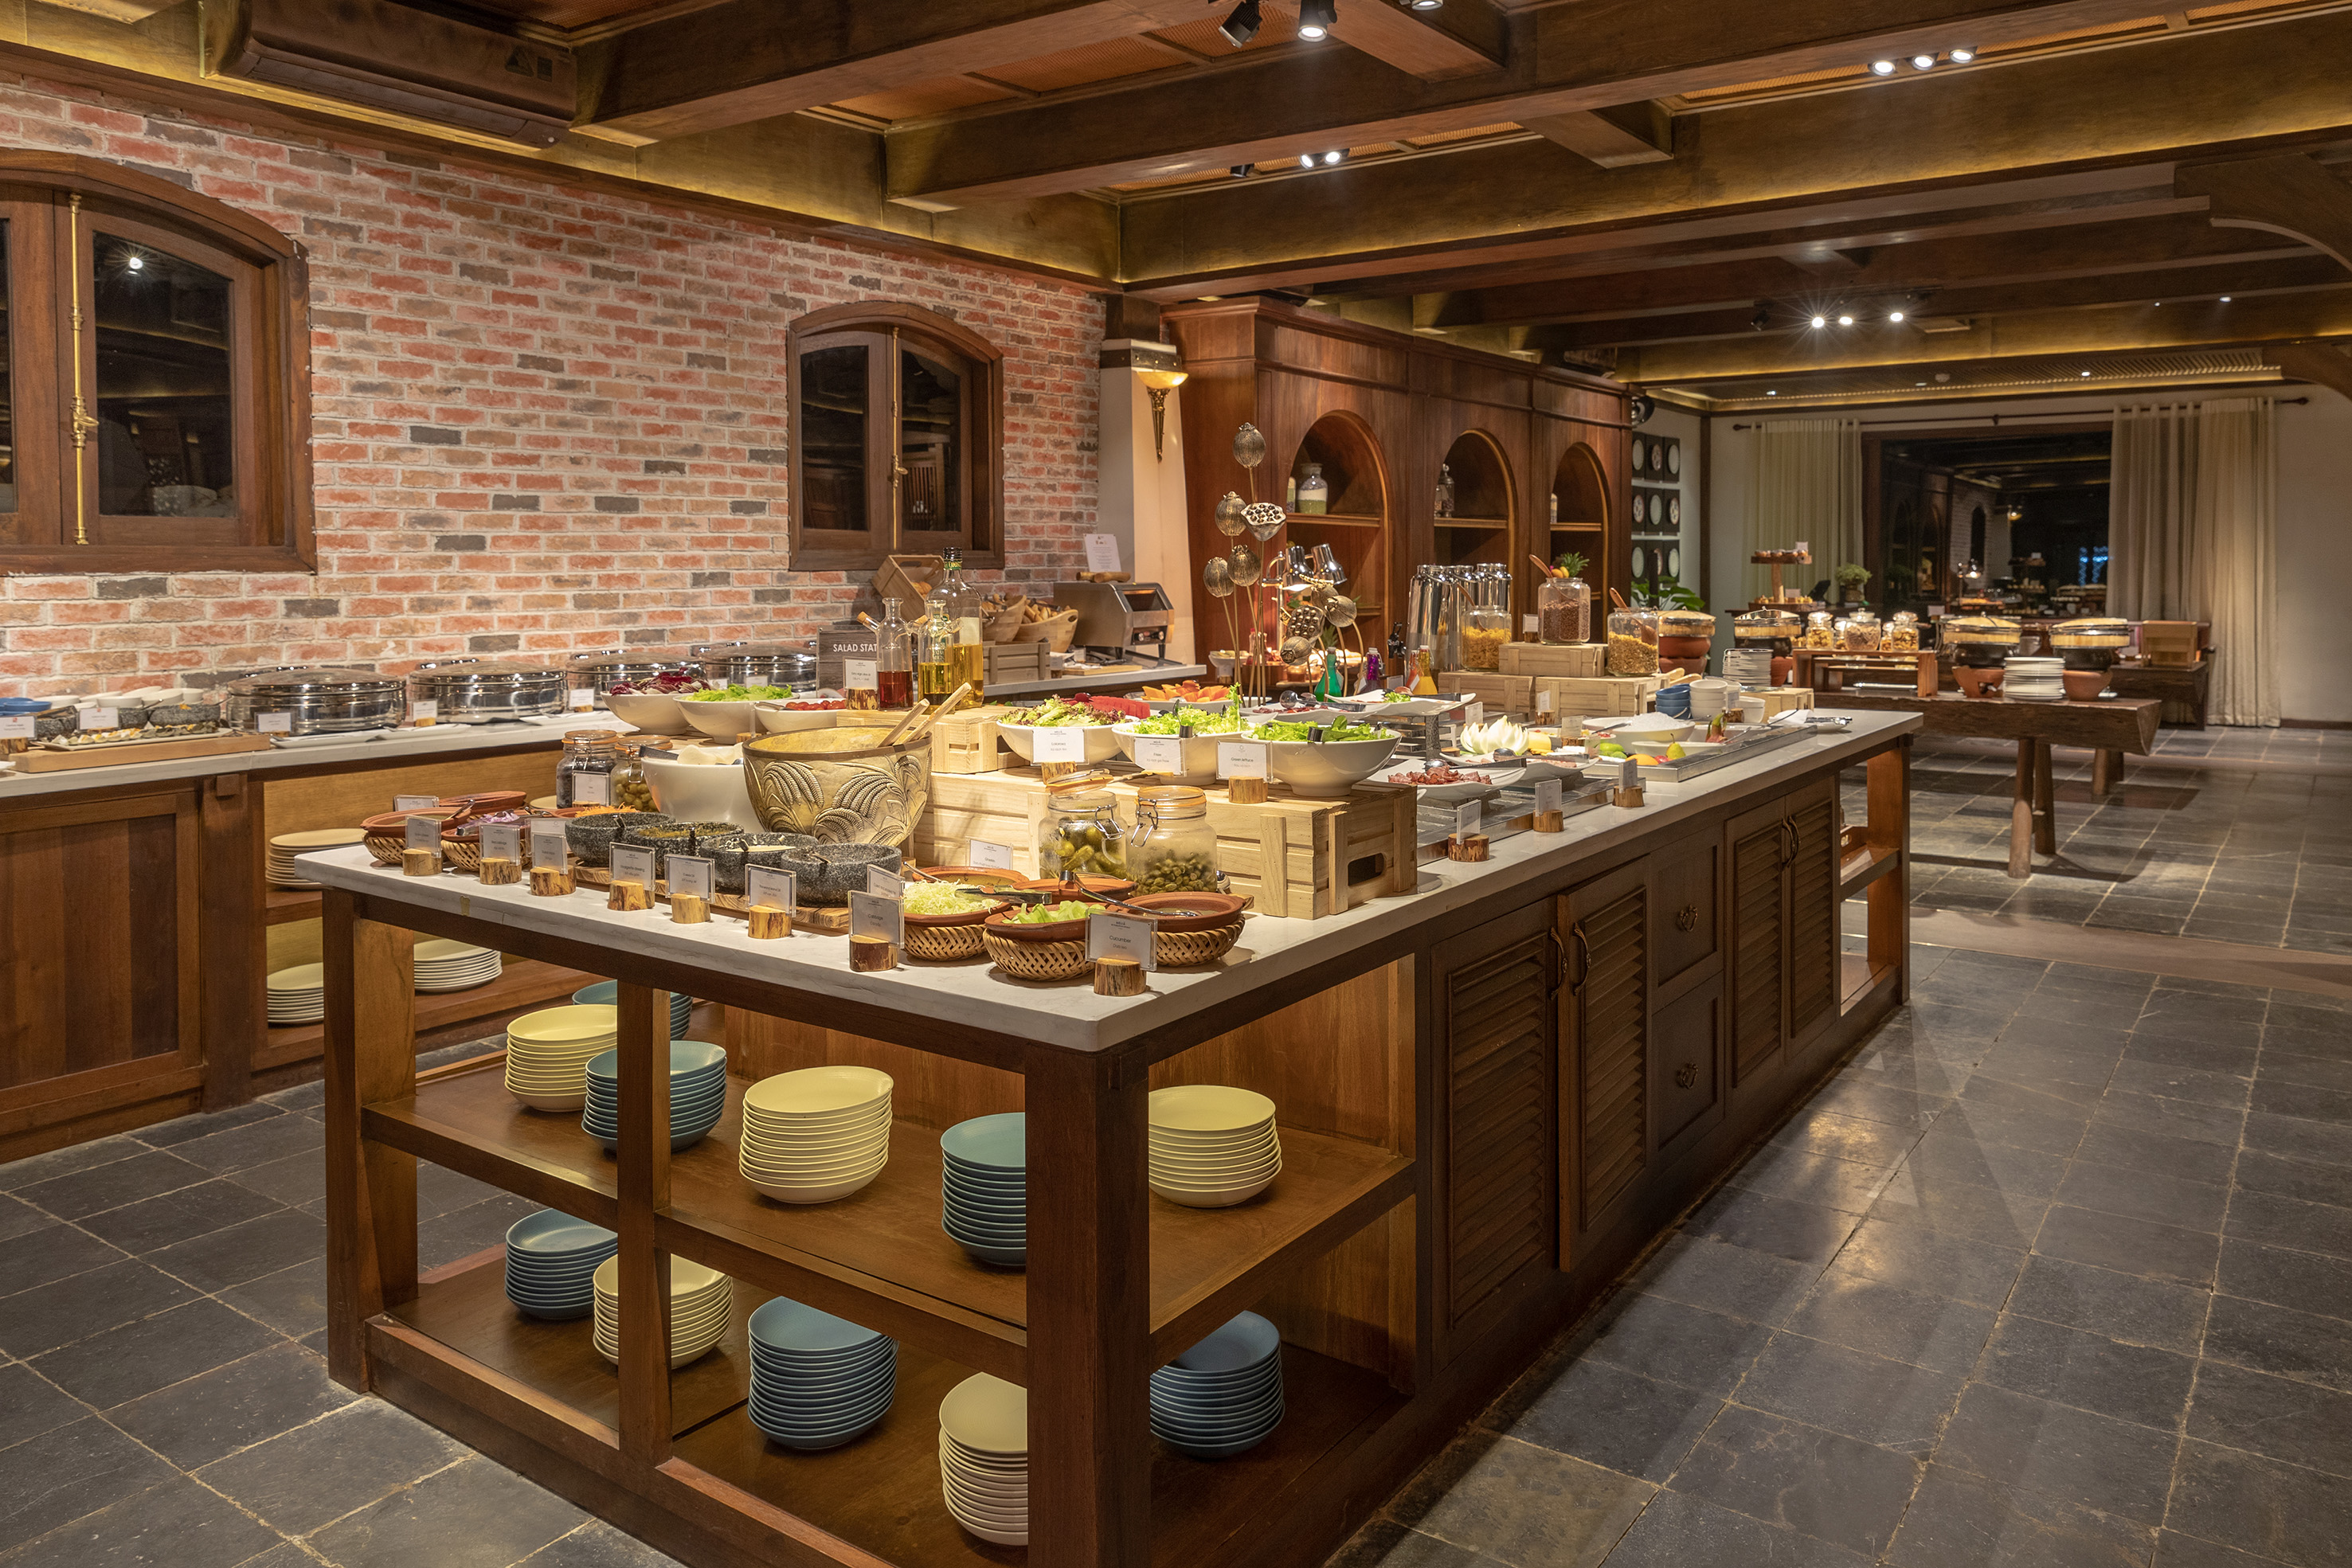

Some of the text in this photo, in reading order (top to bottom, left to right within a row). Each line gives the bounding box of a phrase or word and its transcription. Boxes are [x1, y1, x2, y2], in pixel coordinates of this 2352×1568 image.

[833, 643, 878, 652] SALAD STAT
[1109, 935, 1131, 944] Cucumber
